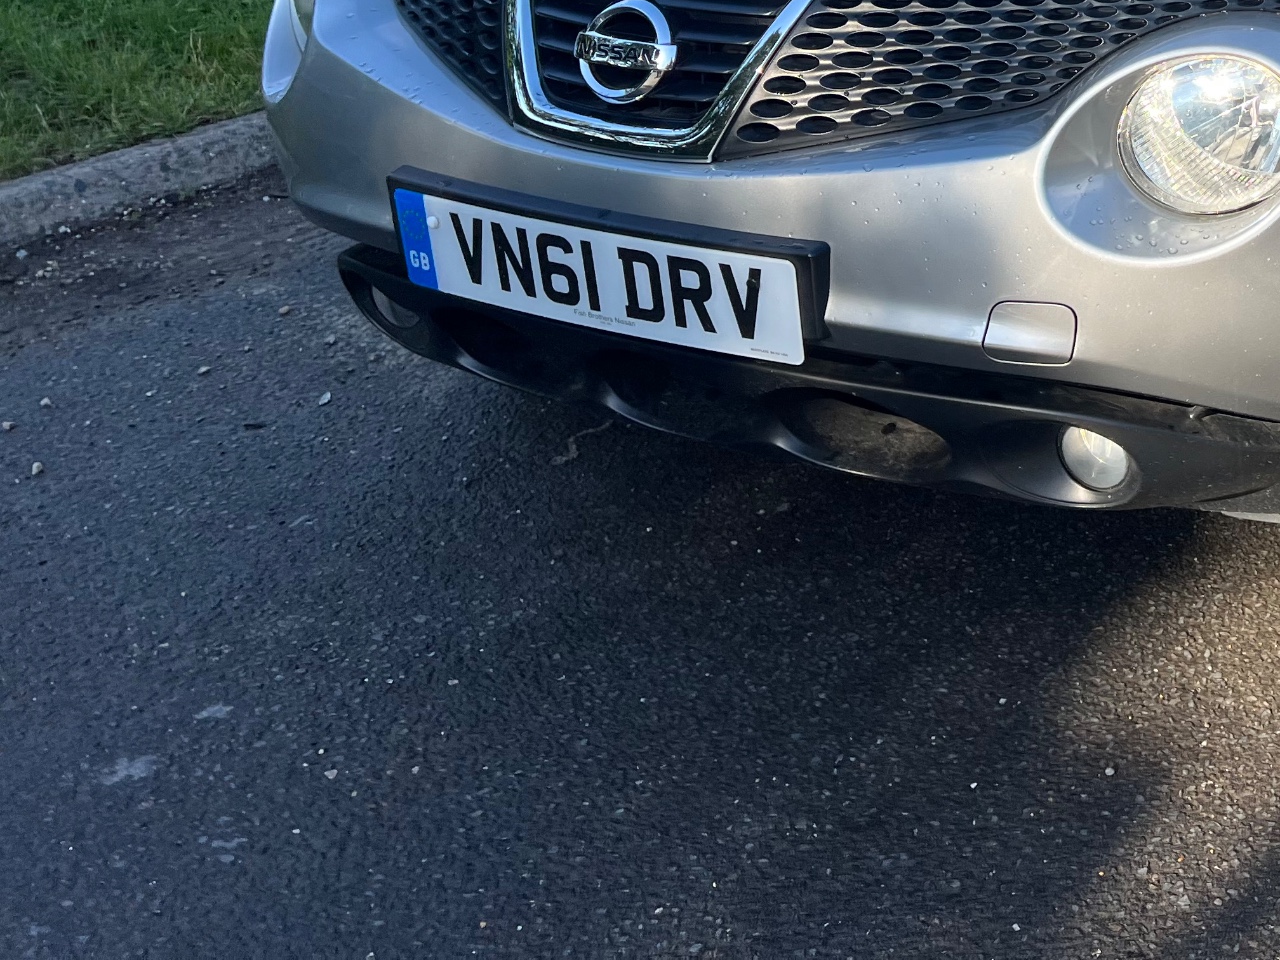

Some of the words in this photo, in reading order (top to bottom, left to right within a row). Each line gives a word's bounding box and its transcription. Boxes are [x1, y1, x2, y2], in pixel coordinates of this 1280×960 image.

[577, 37, 662, 65] NISSAN
[409, 250, 430, 271] GB
[450, 212, 600, 312] VN61
[617, 246, 761, 340] DRV
